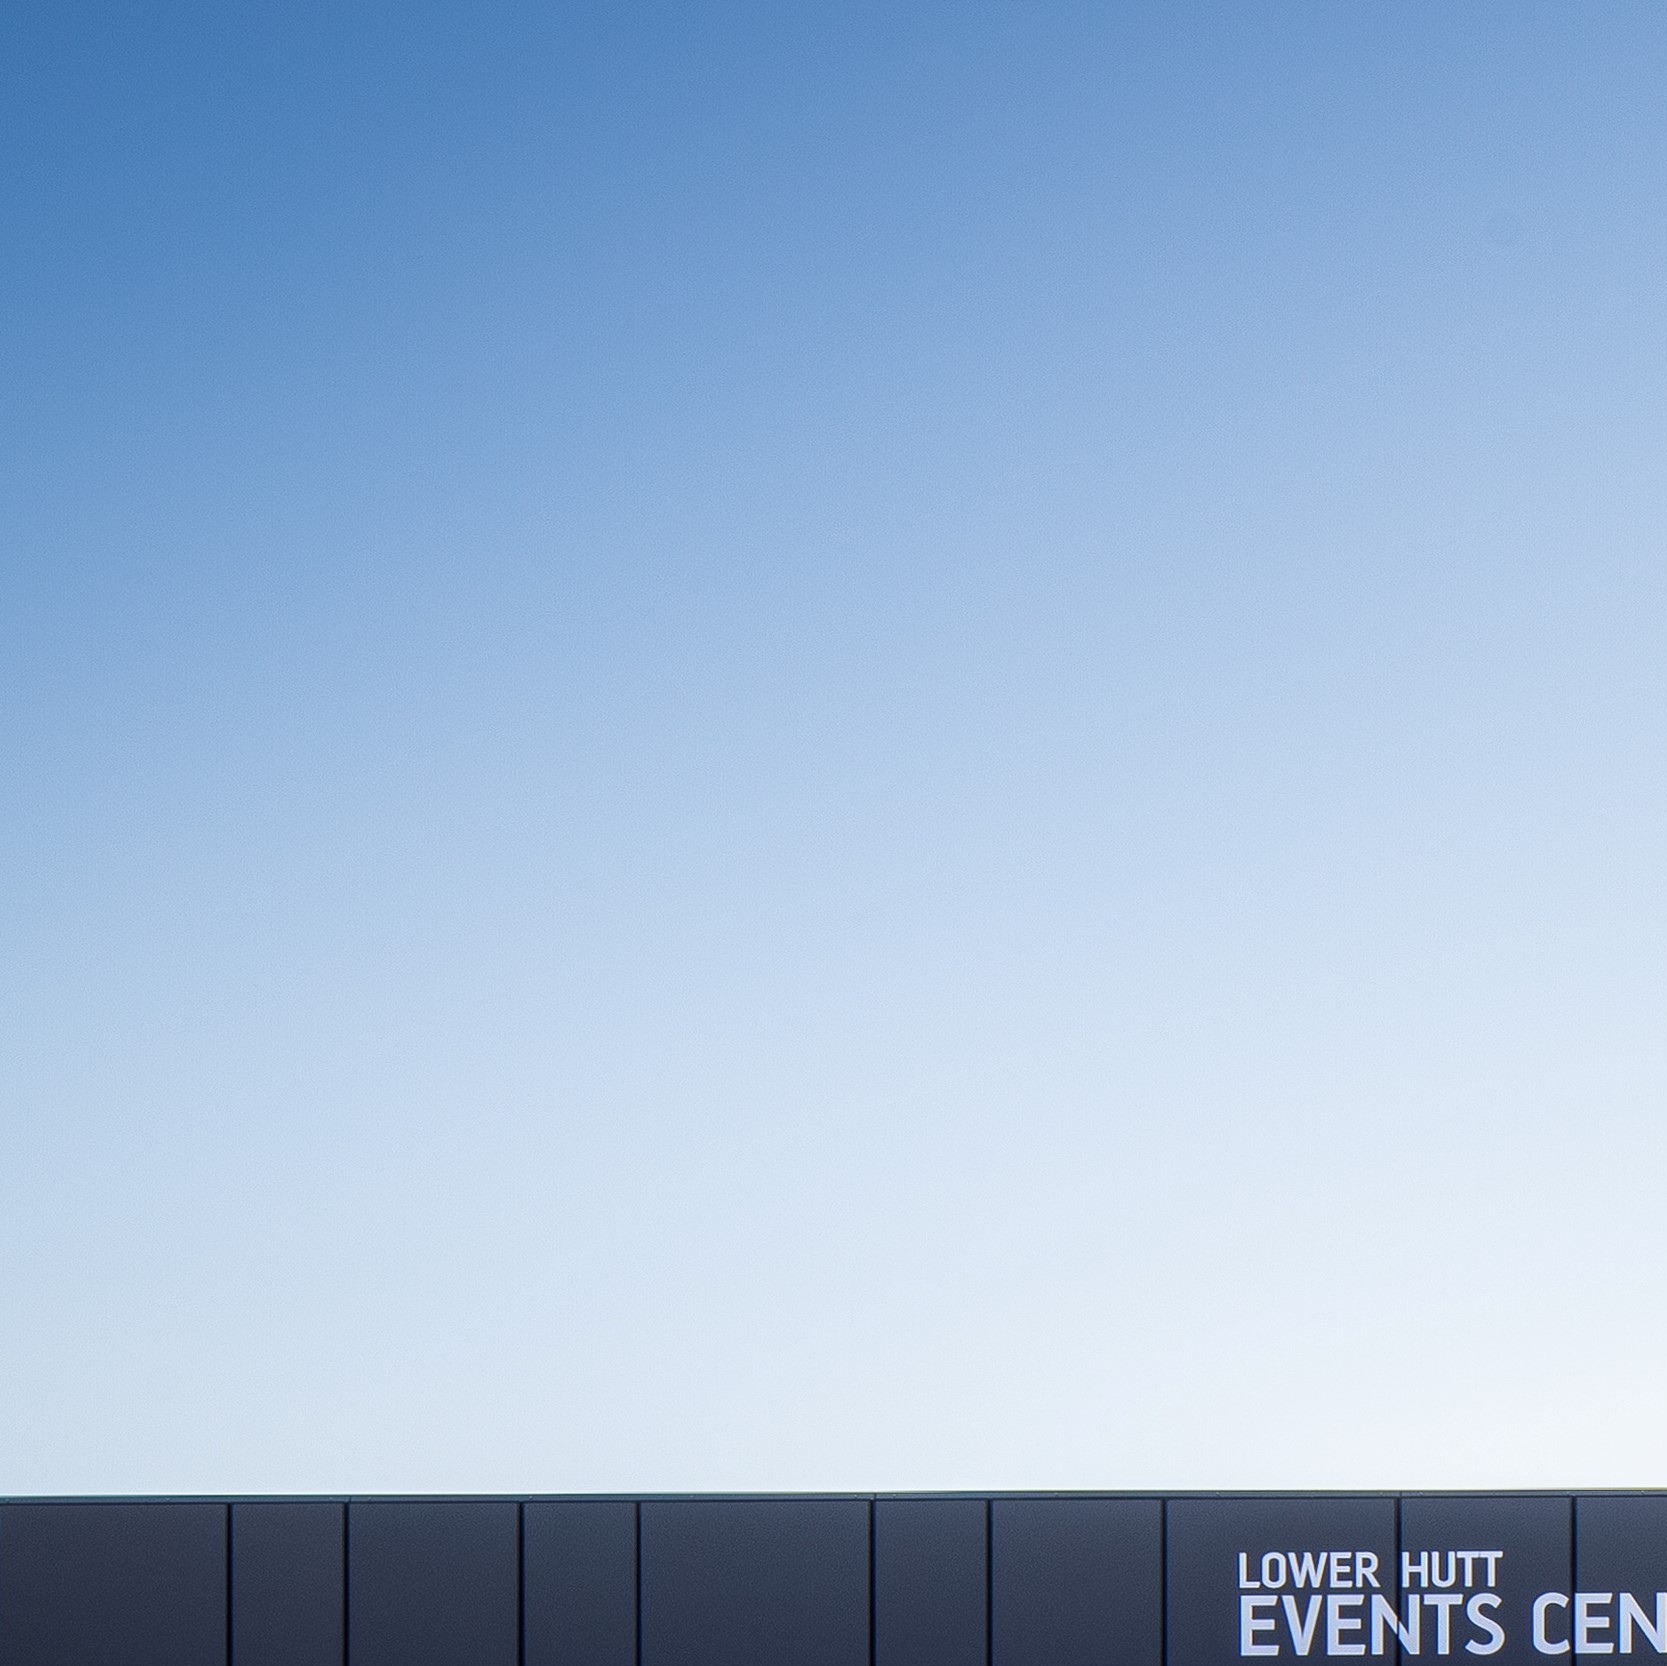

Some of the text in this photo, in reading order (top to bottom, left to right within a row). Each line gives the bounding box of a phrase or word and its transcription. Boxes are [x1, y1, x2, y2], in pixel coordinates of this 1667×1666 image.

[1237, 1550, 1503, 1589] LOWER HUTT
[1238, 1593, 1505, 1657] EVENTS
